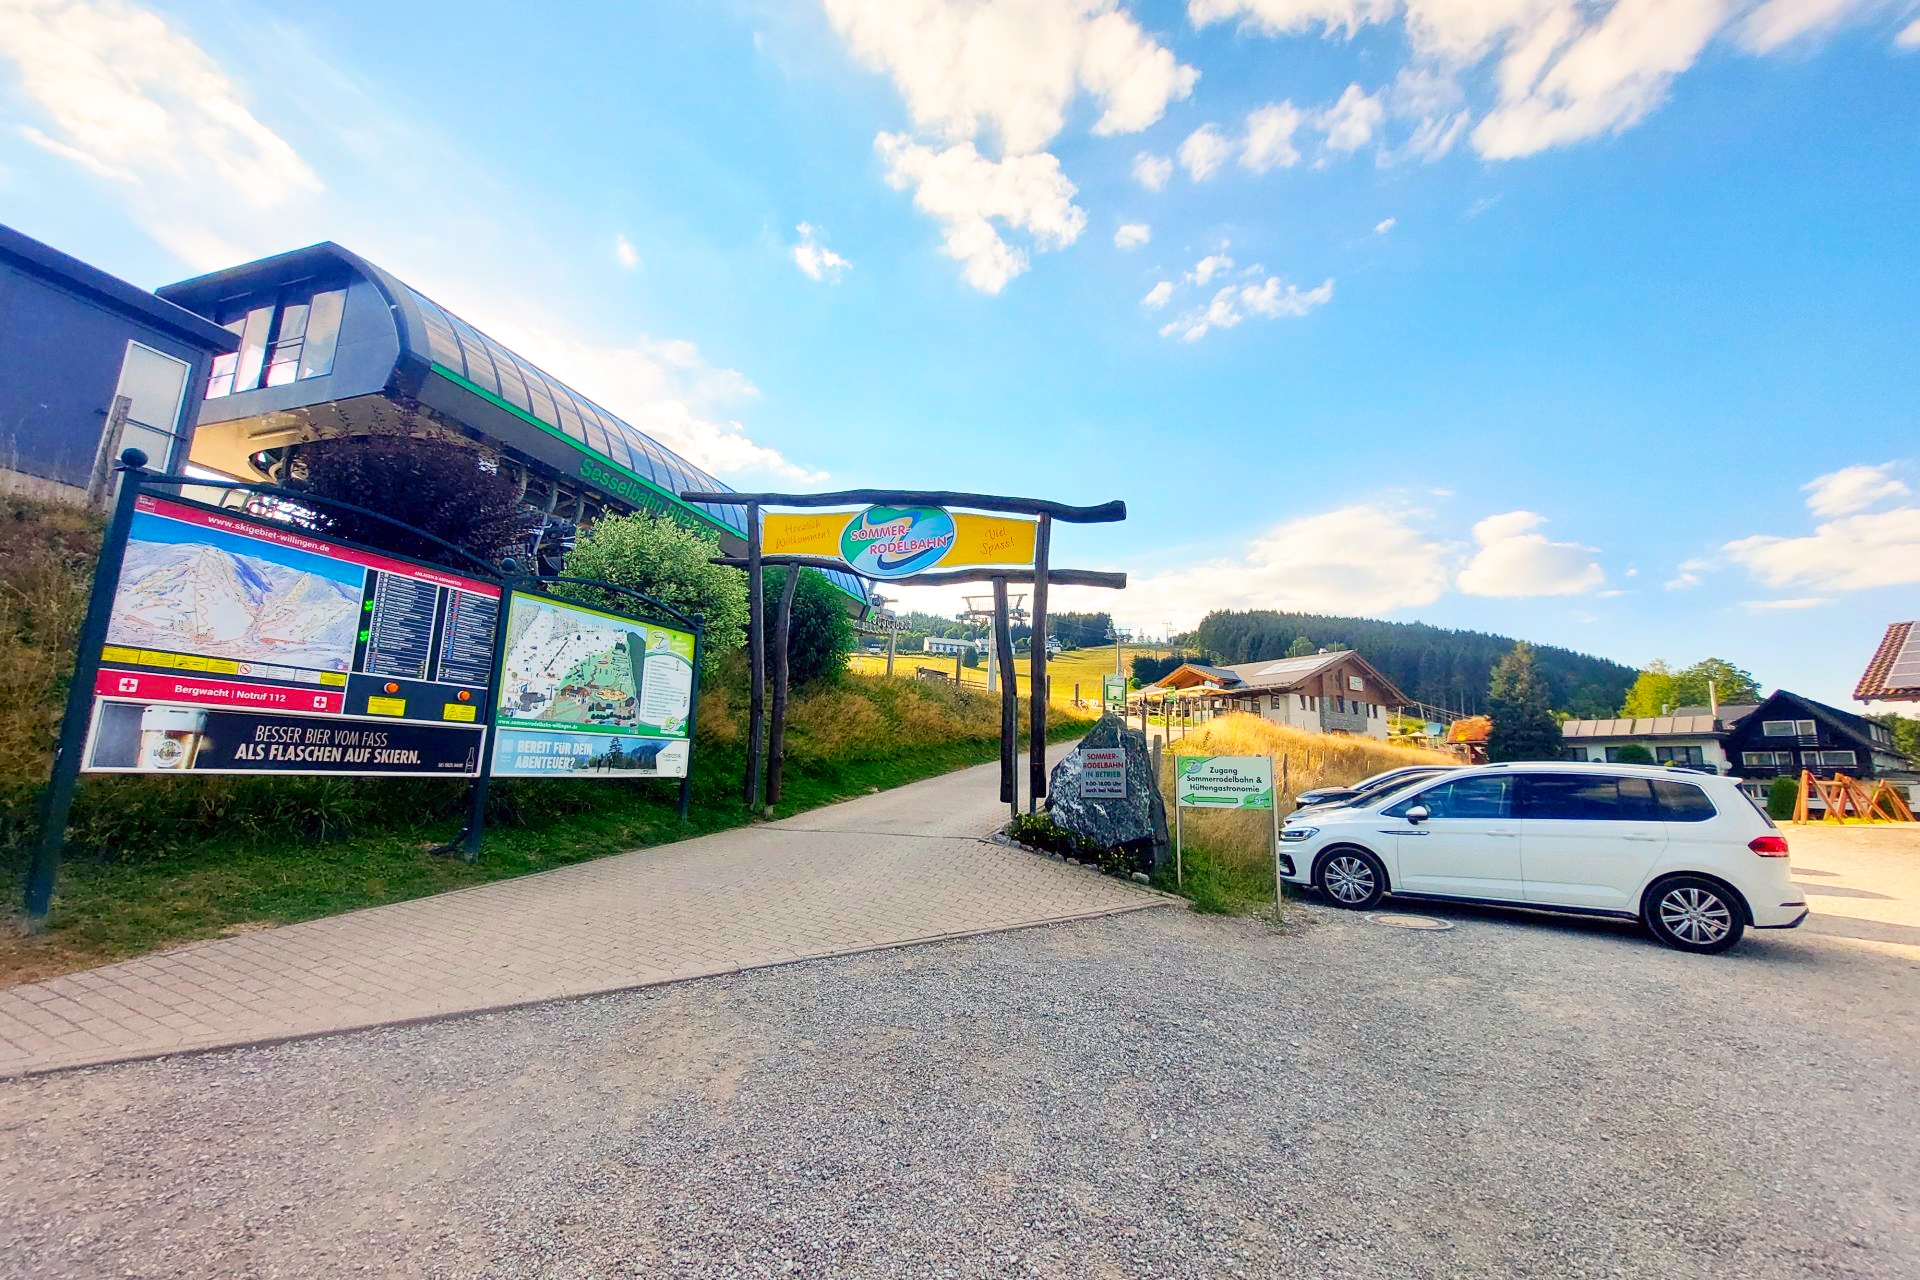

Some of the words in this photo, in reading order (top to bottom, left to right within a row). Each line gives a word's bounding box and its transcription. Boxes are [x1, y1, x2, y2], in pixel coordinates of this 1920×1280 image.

[580, 458, 664, 515] Sesselbahn
[208, 515, 330, 552] www.skigebiet-willingen.de
[784, 520, 821, 536] Herzlich
[851, 525, 911, 541] SOMMER-
[984, 527, 1007, 540] Viel
[775, 530, 831, 549] Willkommen!
[869, 536, 948, 555] RODELBAHN
[979, 537, 1015, 556] Spass!
[174, 684, 229, 698] Bergwacht
[236, 690, 268, 701] Notruf
[269, 693, 286, 702] 112
[255, 725, 302, 743] BESSER
[304, 728, 330, 745] BIER
[334, 730, 360, 746] VOM
[361, 732, 388, 747] FASS
[234, 743, 265, 760] ALS
[268, 744, 342, 762] FLASCHEN
[343, 748, 372, 763] AUF
[373, 749, 421, 764] SKIERN.
[517, 740, 552, 754] BEREIT
[553, 741, 572, 754] FÜR
[572, 743, 593, 755] DEIN
[514, 755, 576, 769] ABENTEUER?
[1186, 775, 1254, 784] Sommerrodelbahn
[1255, 776, 1262, 784] &
[1209, 766, 1238, 776] Zugang
[1189, 783, 1260, 793] Hüttengastronomie
